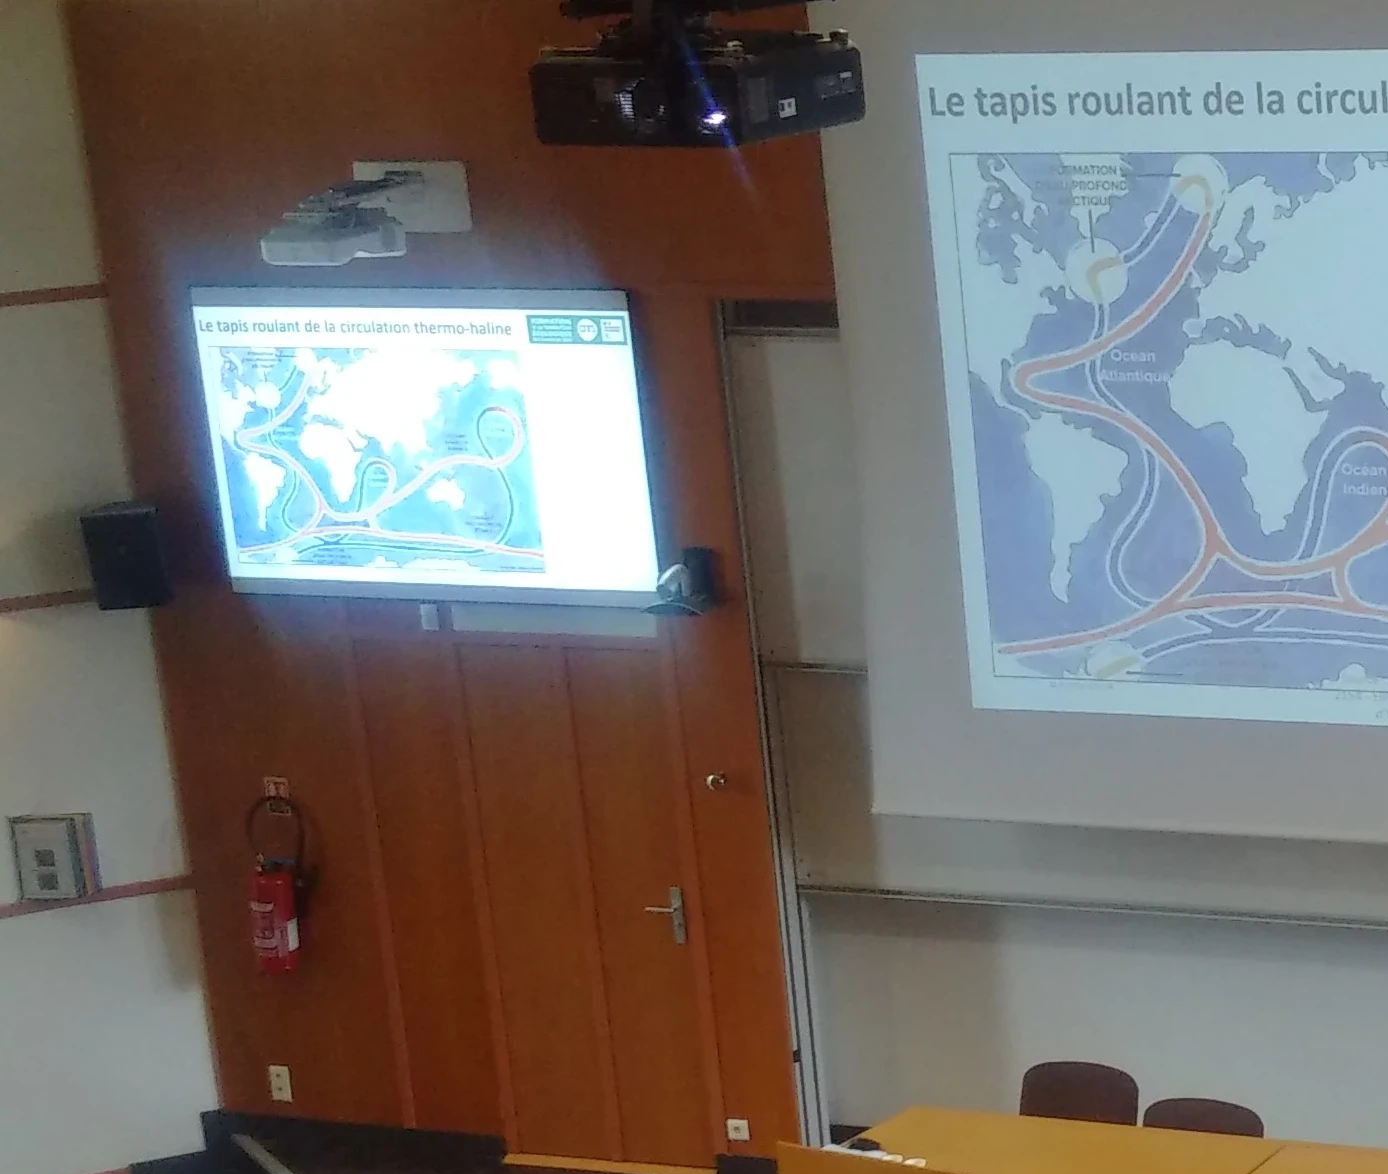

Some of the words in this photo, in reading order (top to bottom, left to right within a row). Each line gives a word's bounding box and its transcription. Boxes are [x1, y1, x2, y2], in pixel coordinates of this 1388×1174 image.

[928, 86, 965, 117] Le
[973, 84, 1057, 124] tapis
[1067, 82, 1193, 116] roulant
[1202, 81, 1244, 116] de
[1256, 81, 1285, 116] la
[199, 319, 213, 333] Le
[217, 319, 249, 335] tapis
[252, 320, 300, 333] roulant
[304, 319, 321, 333] de
[325, 320, 336, 333] la
[340, 320, 411, 334] circulation
[414, 321, 512, 336] thermo-haline
